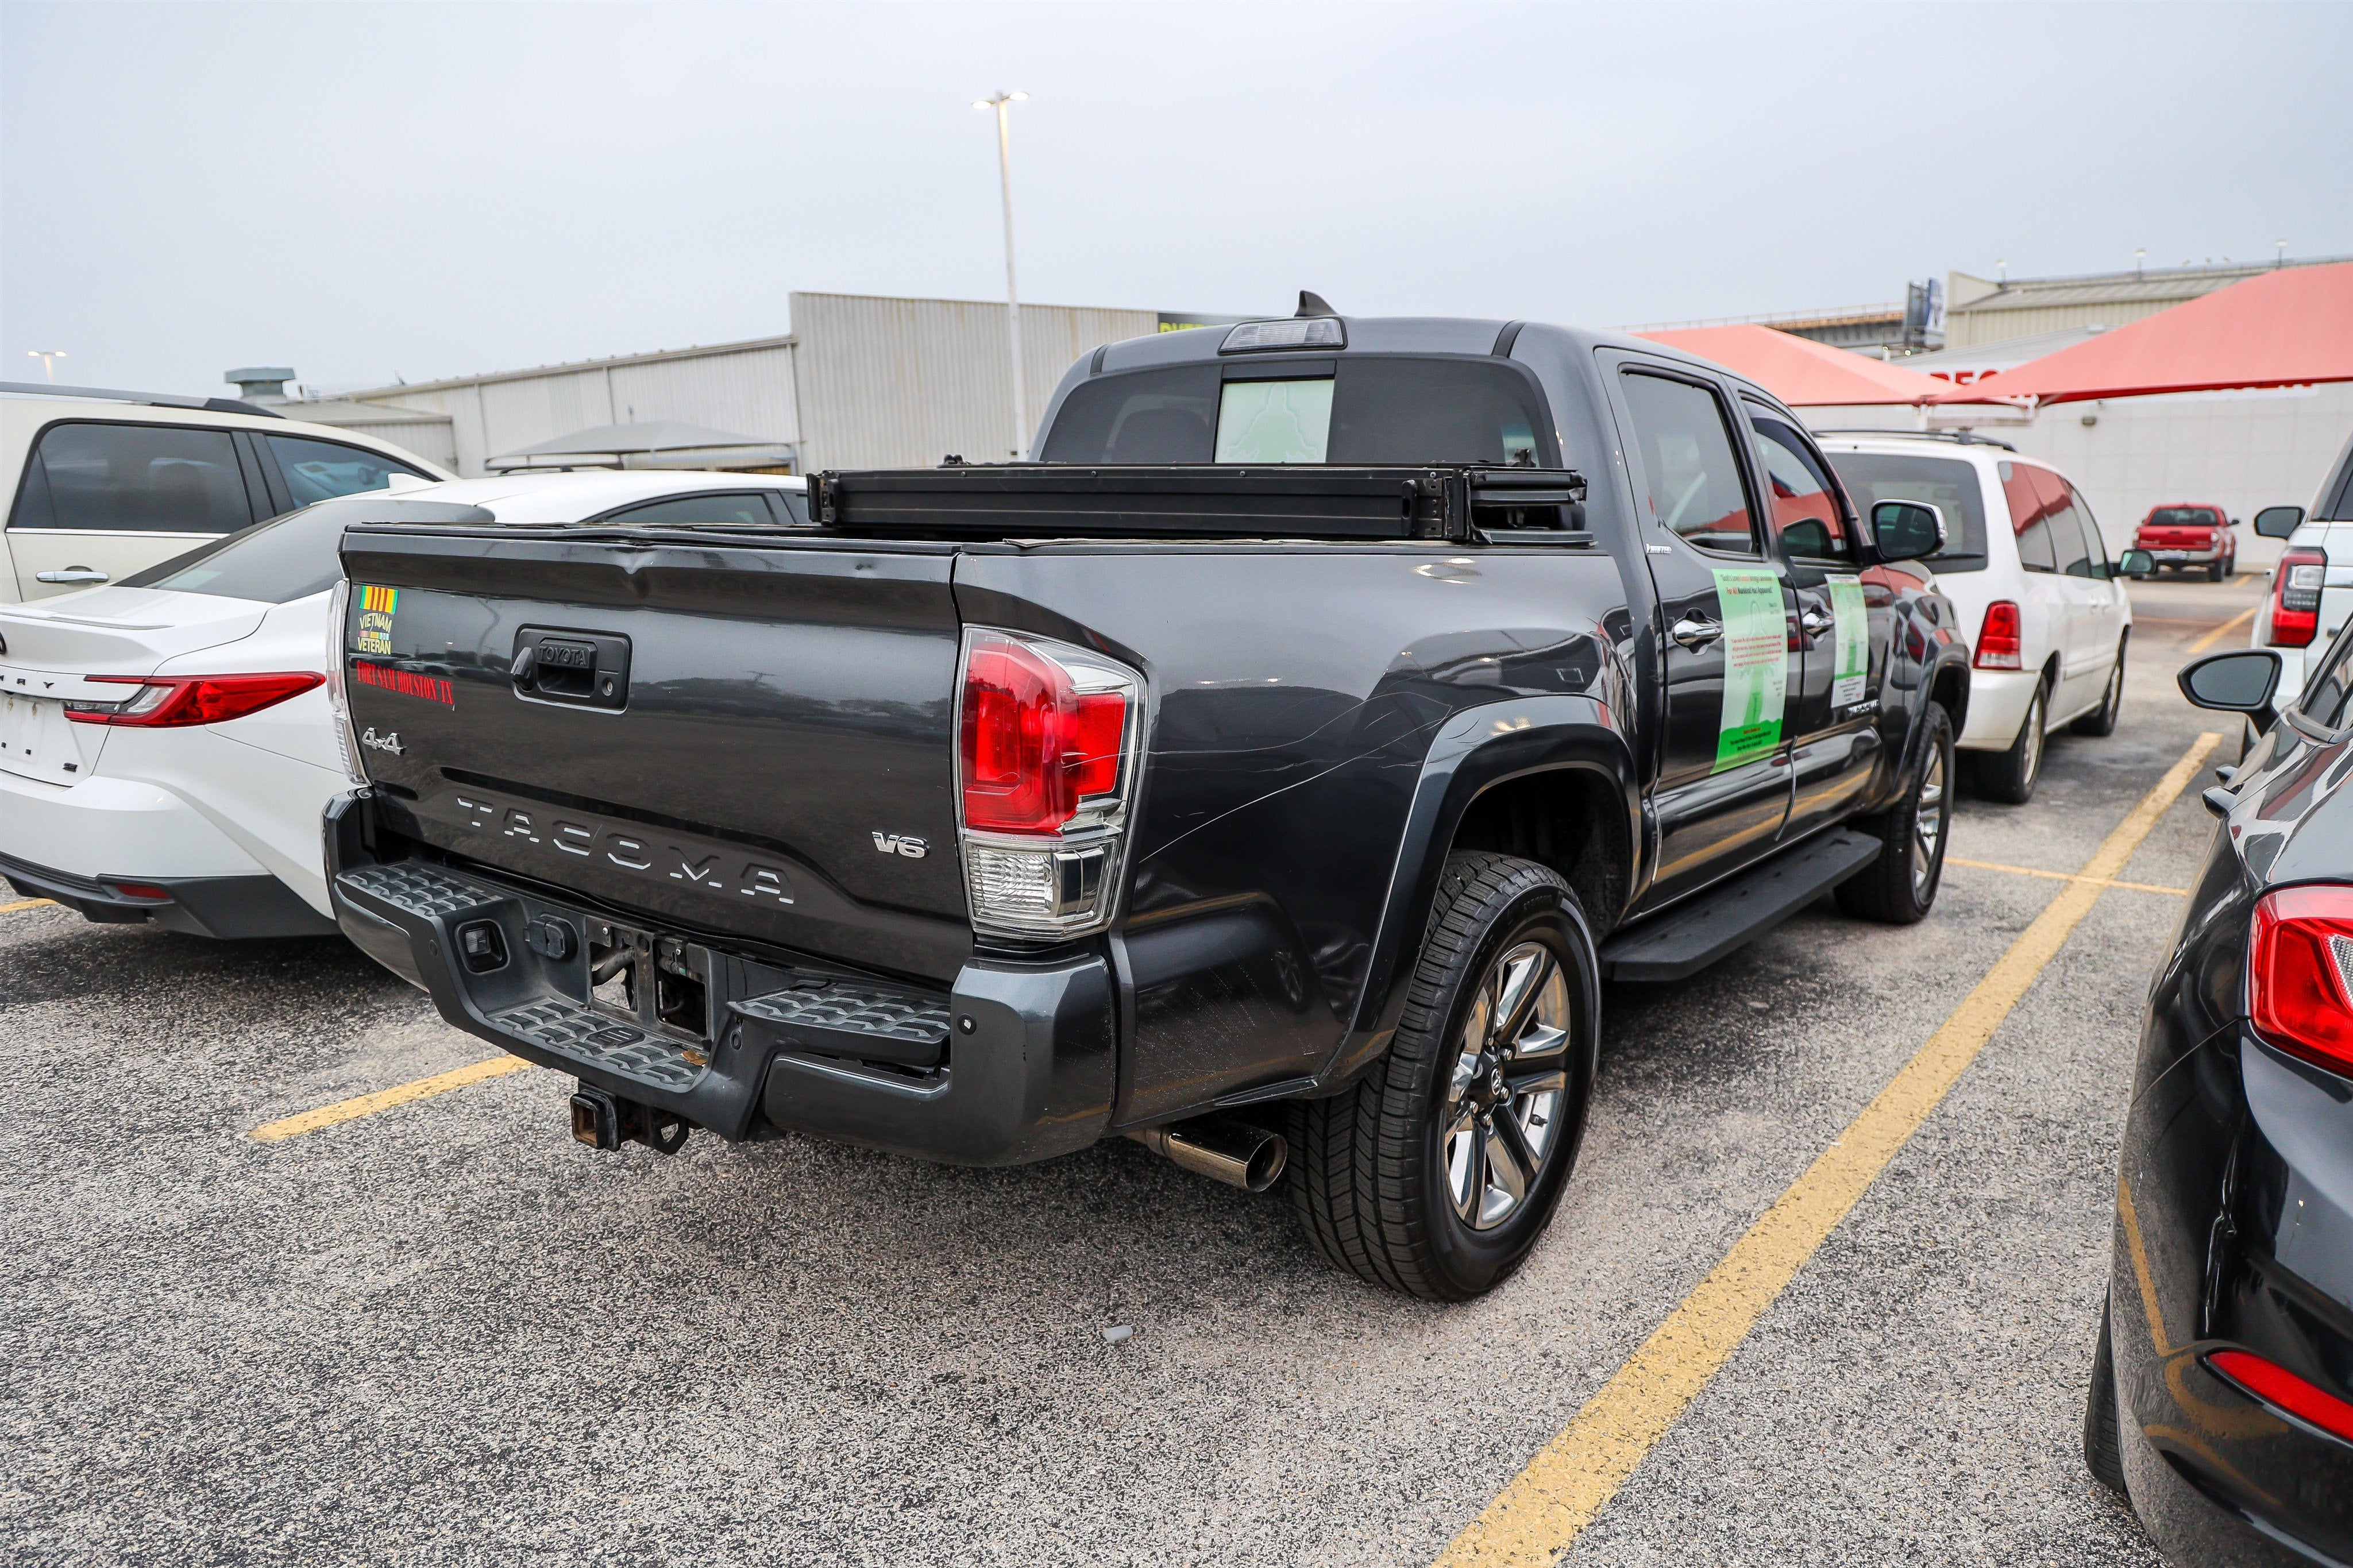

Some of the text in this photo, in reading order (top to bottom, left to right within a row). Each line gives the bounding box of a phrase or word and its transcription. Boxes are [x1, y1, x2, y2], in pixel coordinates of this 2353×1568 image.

[359, 612, 392, 634] VIETNAM
[357, 637, 391, 655] VETERAN
[538, 646, 588, 666] TOYOTA
[356, 661, 376, 686] FORT
[377, 666, 396, 691] SAM
[439, 680, 454, 704] TX
[456, 796, 795, 905] TACOMA
[871, 831, 927, 858] V6
